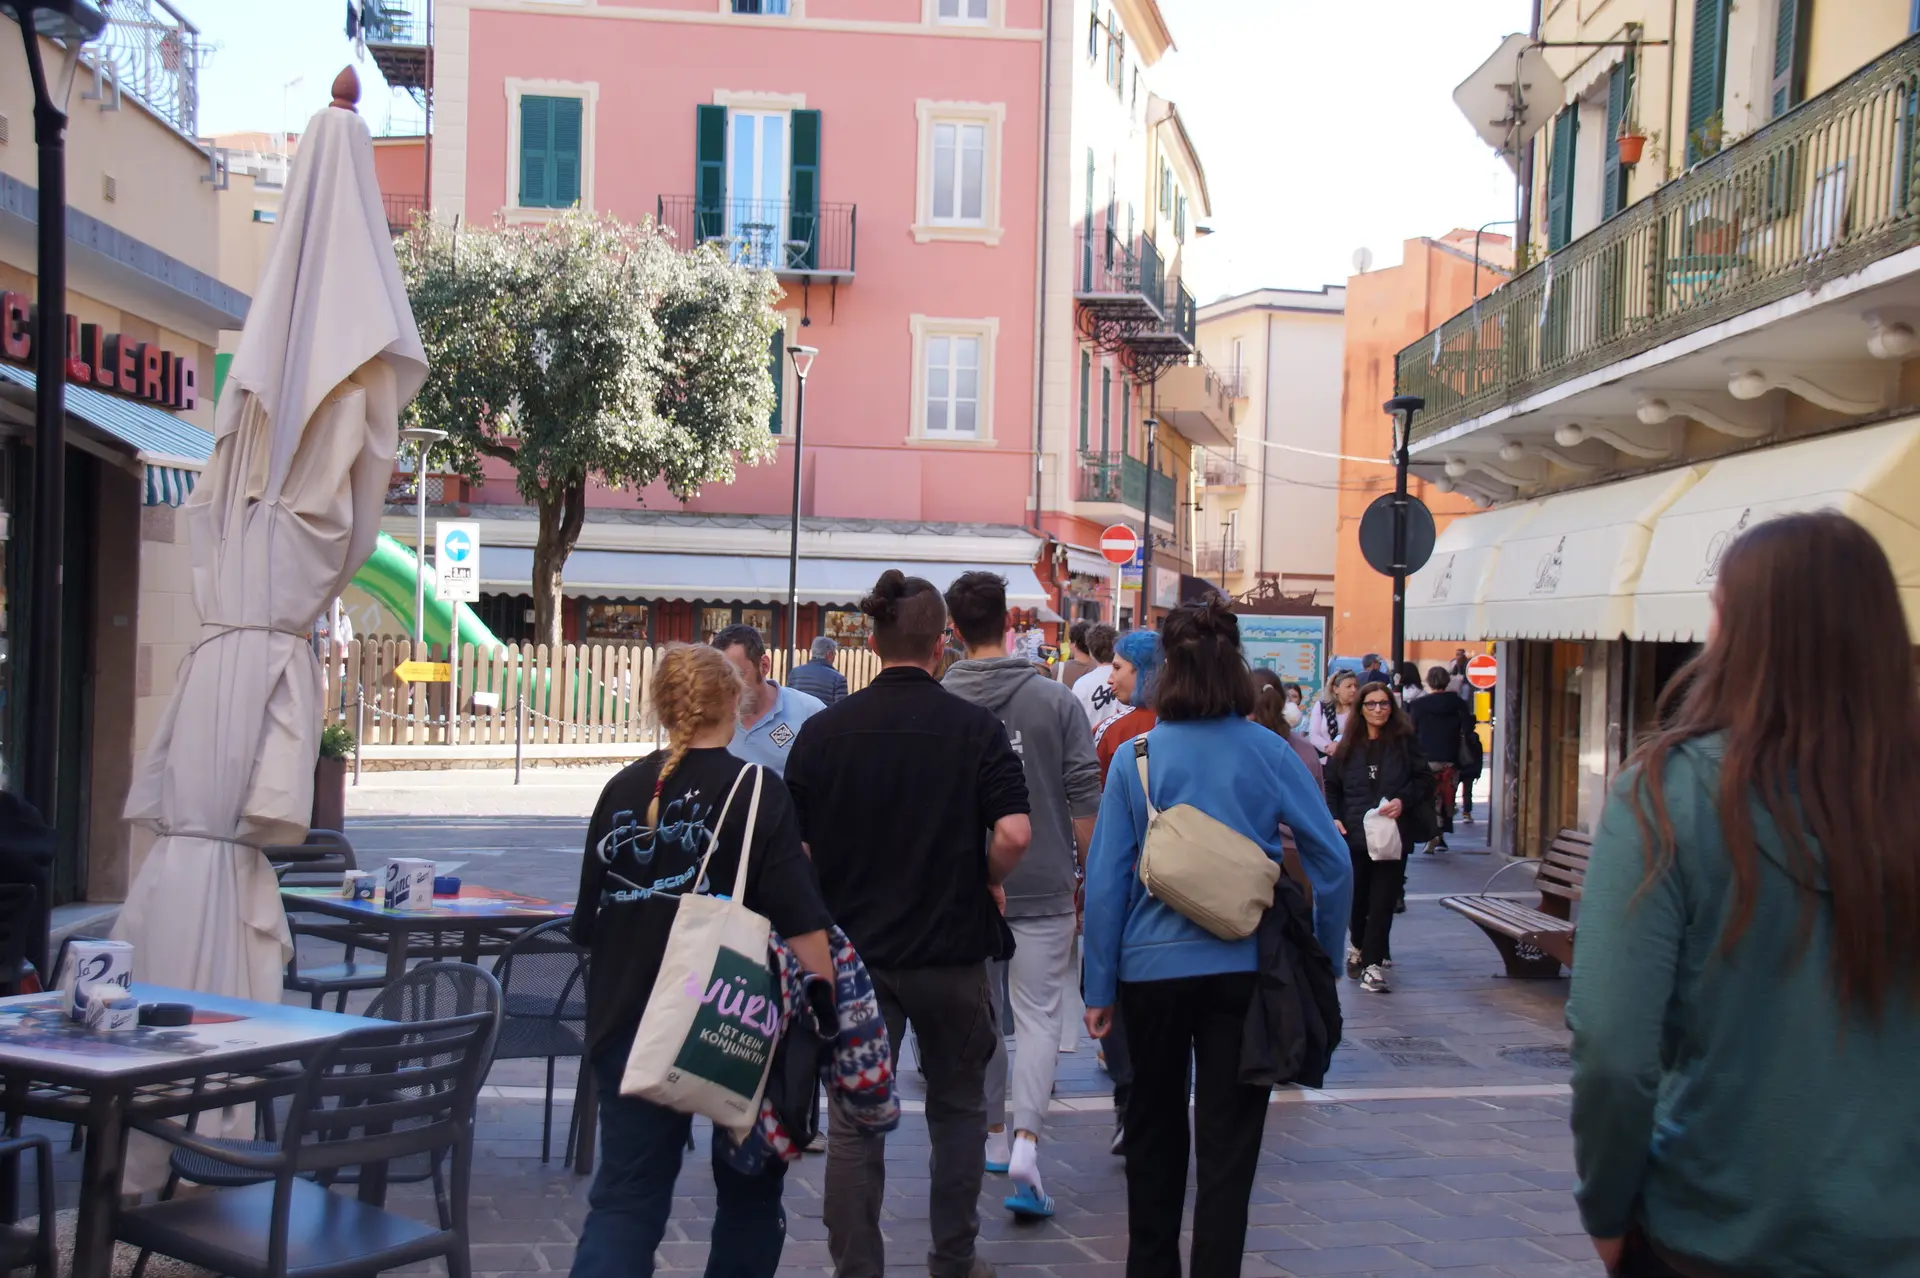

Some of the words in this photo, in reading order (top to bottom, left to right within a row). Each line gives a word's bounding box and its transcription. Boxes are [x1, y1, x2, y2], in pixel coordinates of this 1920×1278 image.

[1, 290, 198, 411] CLLERIA
[684, 971, 780, 1037] WÜRD
[699, 1028, 766, 1065] KONJUNKTIV
[718, 1021, 739, 1038] IST
[739, 1032, 765, 1052] KEIN
